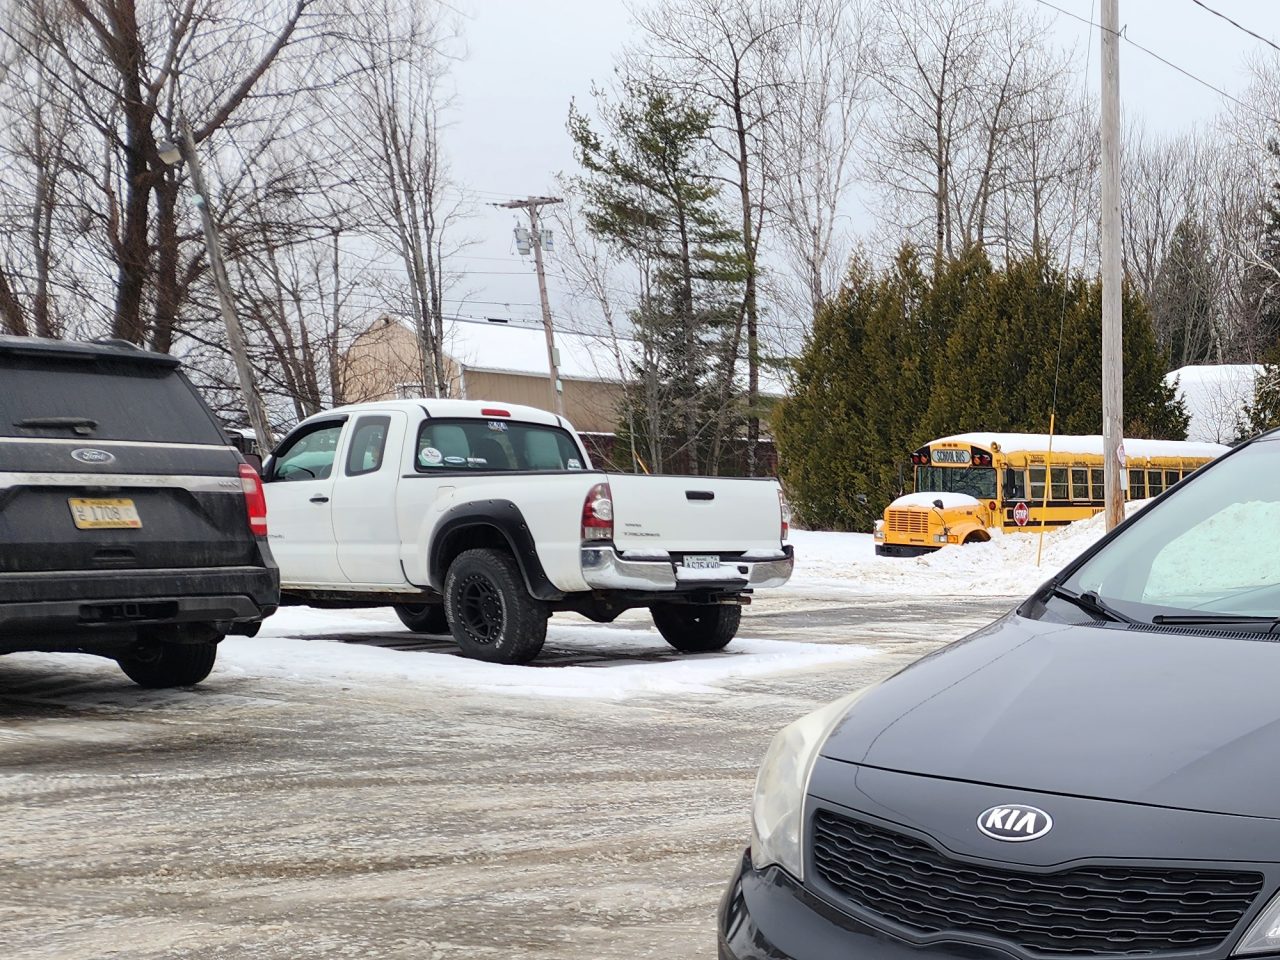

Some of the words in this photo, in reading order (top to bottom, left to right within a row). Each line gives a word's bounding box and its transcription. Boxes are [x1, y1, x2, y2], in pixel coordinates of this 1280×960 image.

[936, 450, 955, 463] SCHOOL
[956, 451, 966, 463] BUS
[1015, 508, 1027, 519] STOP
[984, 809, 1035, 835] KIA
